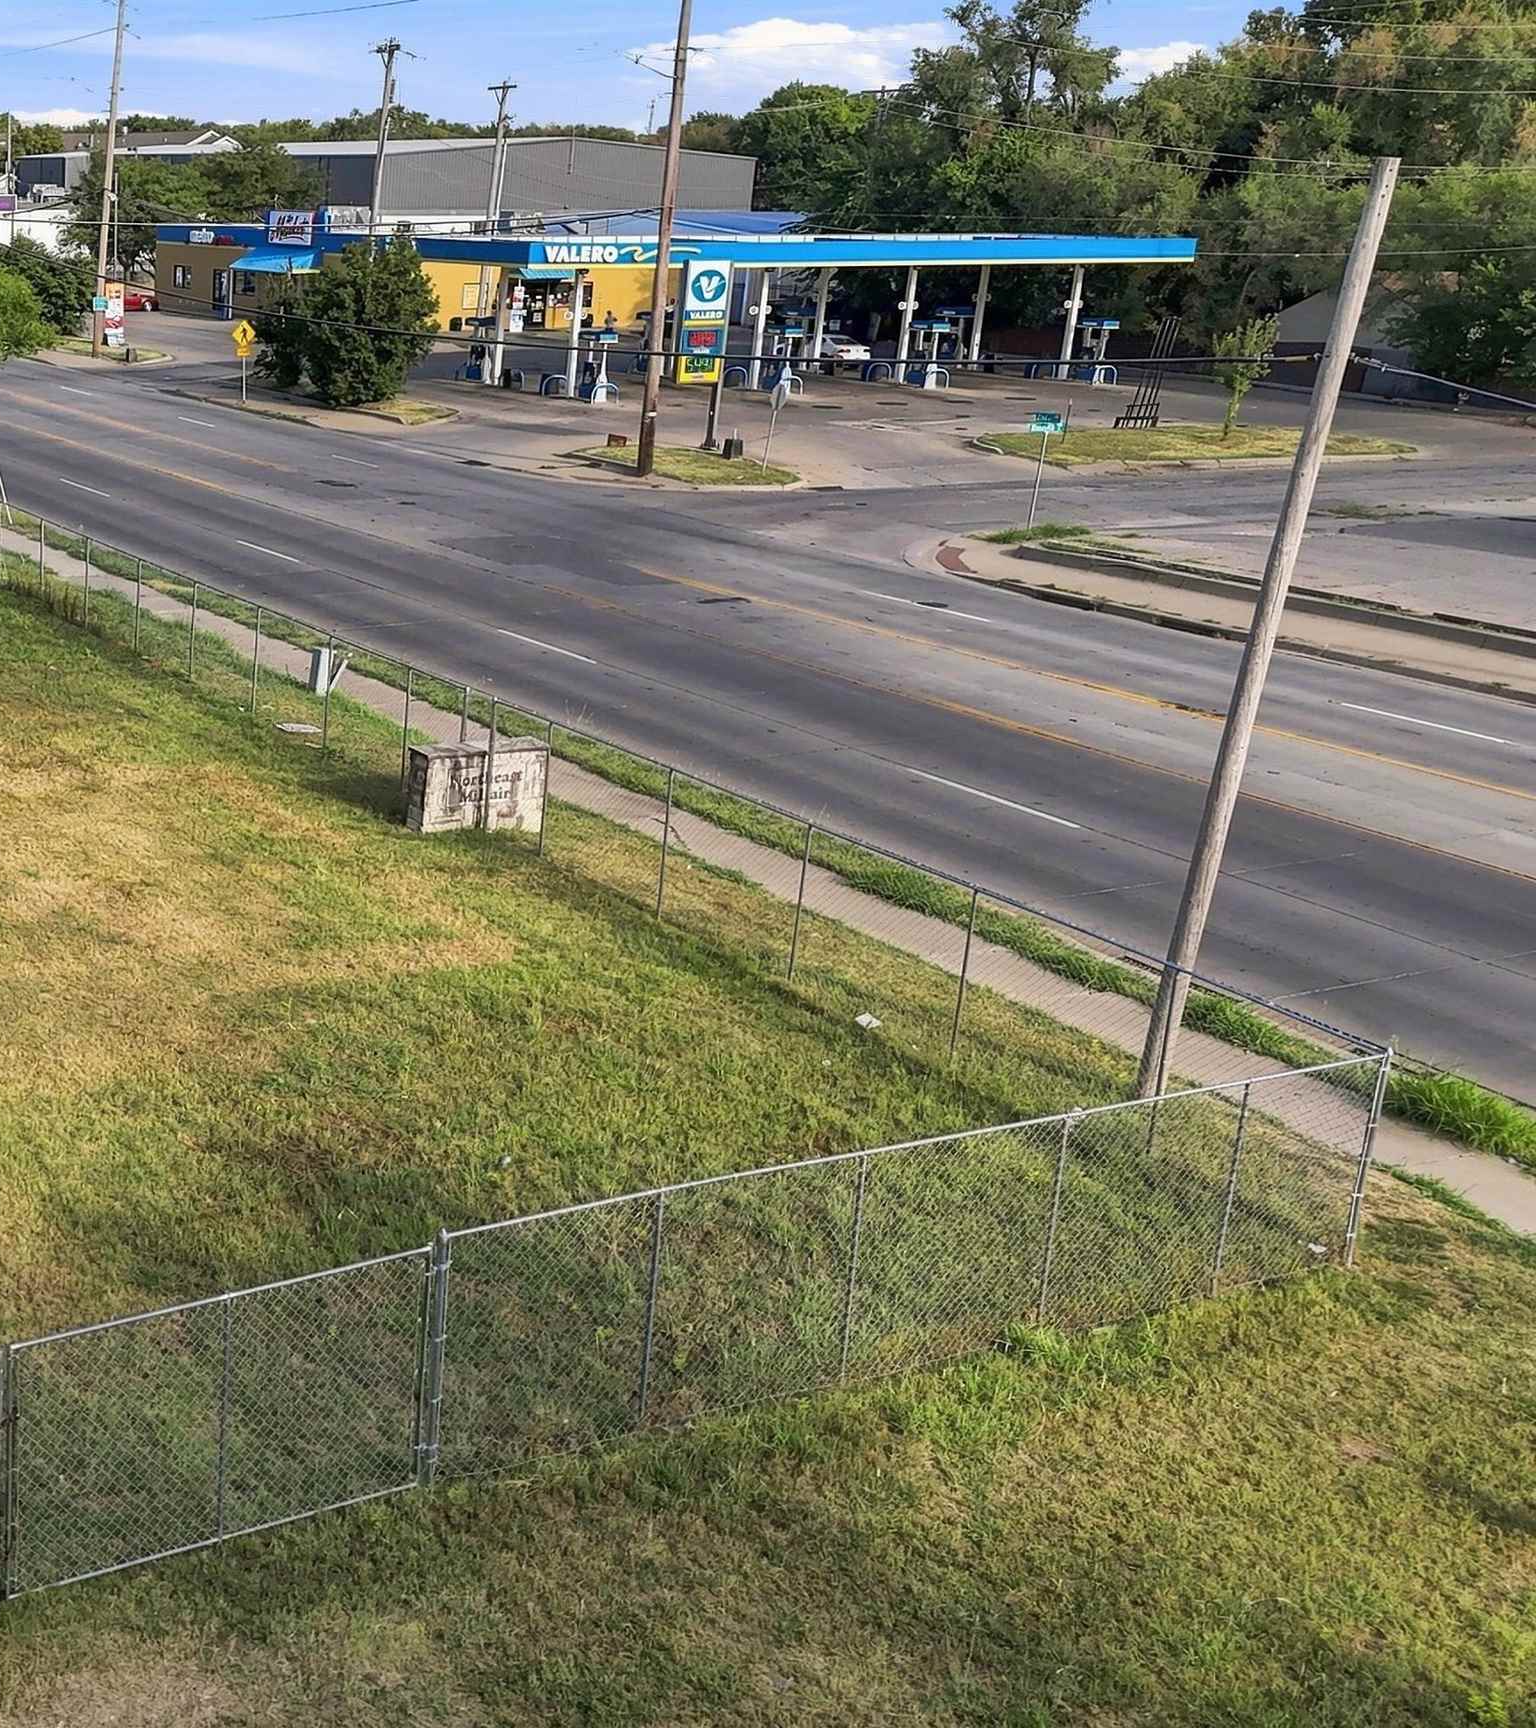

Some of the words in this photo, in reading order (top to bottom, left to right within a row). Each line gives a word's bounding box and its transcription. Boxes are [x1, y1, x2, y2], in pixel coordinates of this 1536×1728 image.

[544, 245, 618, 263] VALERO
[689, 311, 724, 320] VALERO
[449, 769, 523, 788] Norteast
[460, 785, 512, 802] Milair
